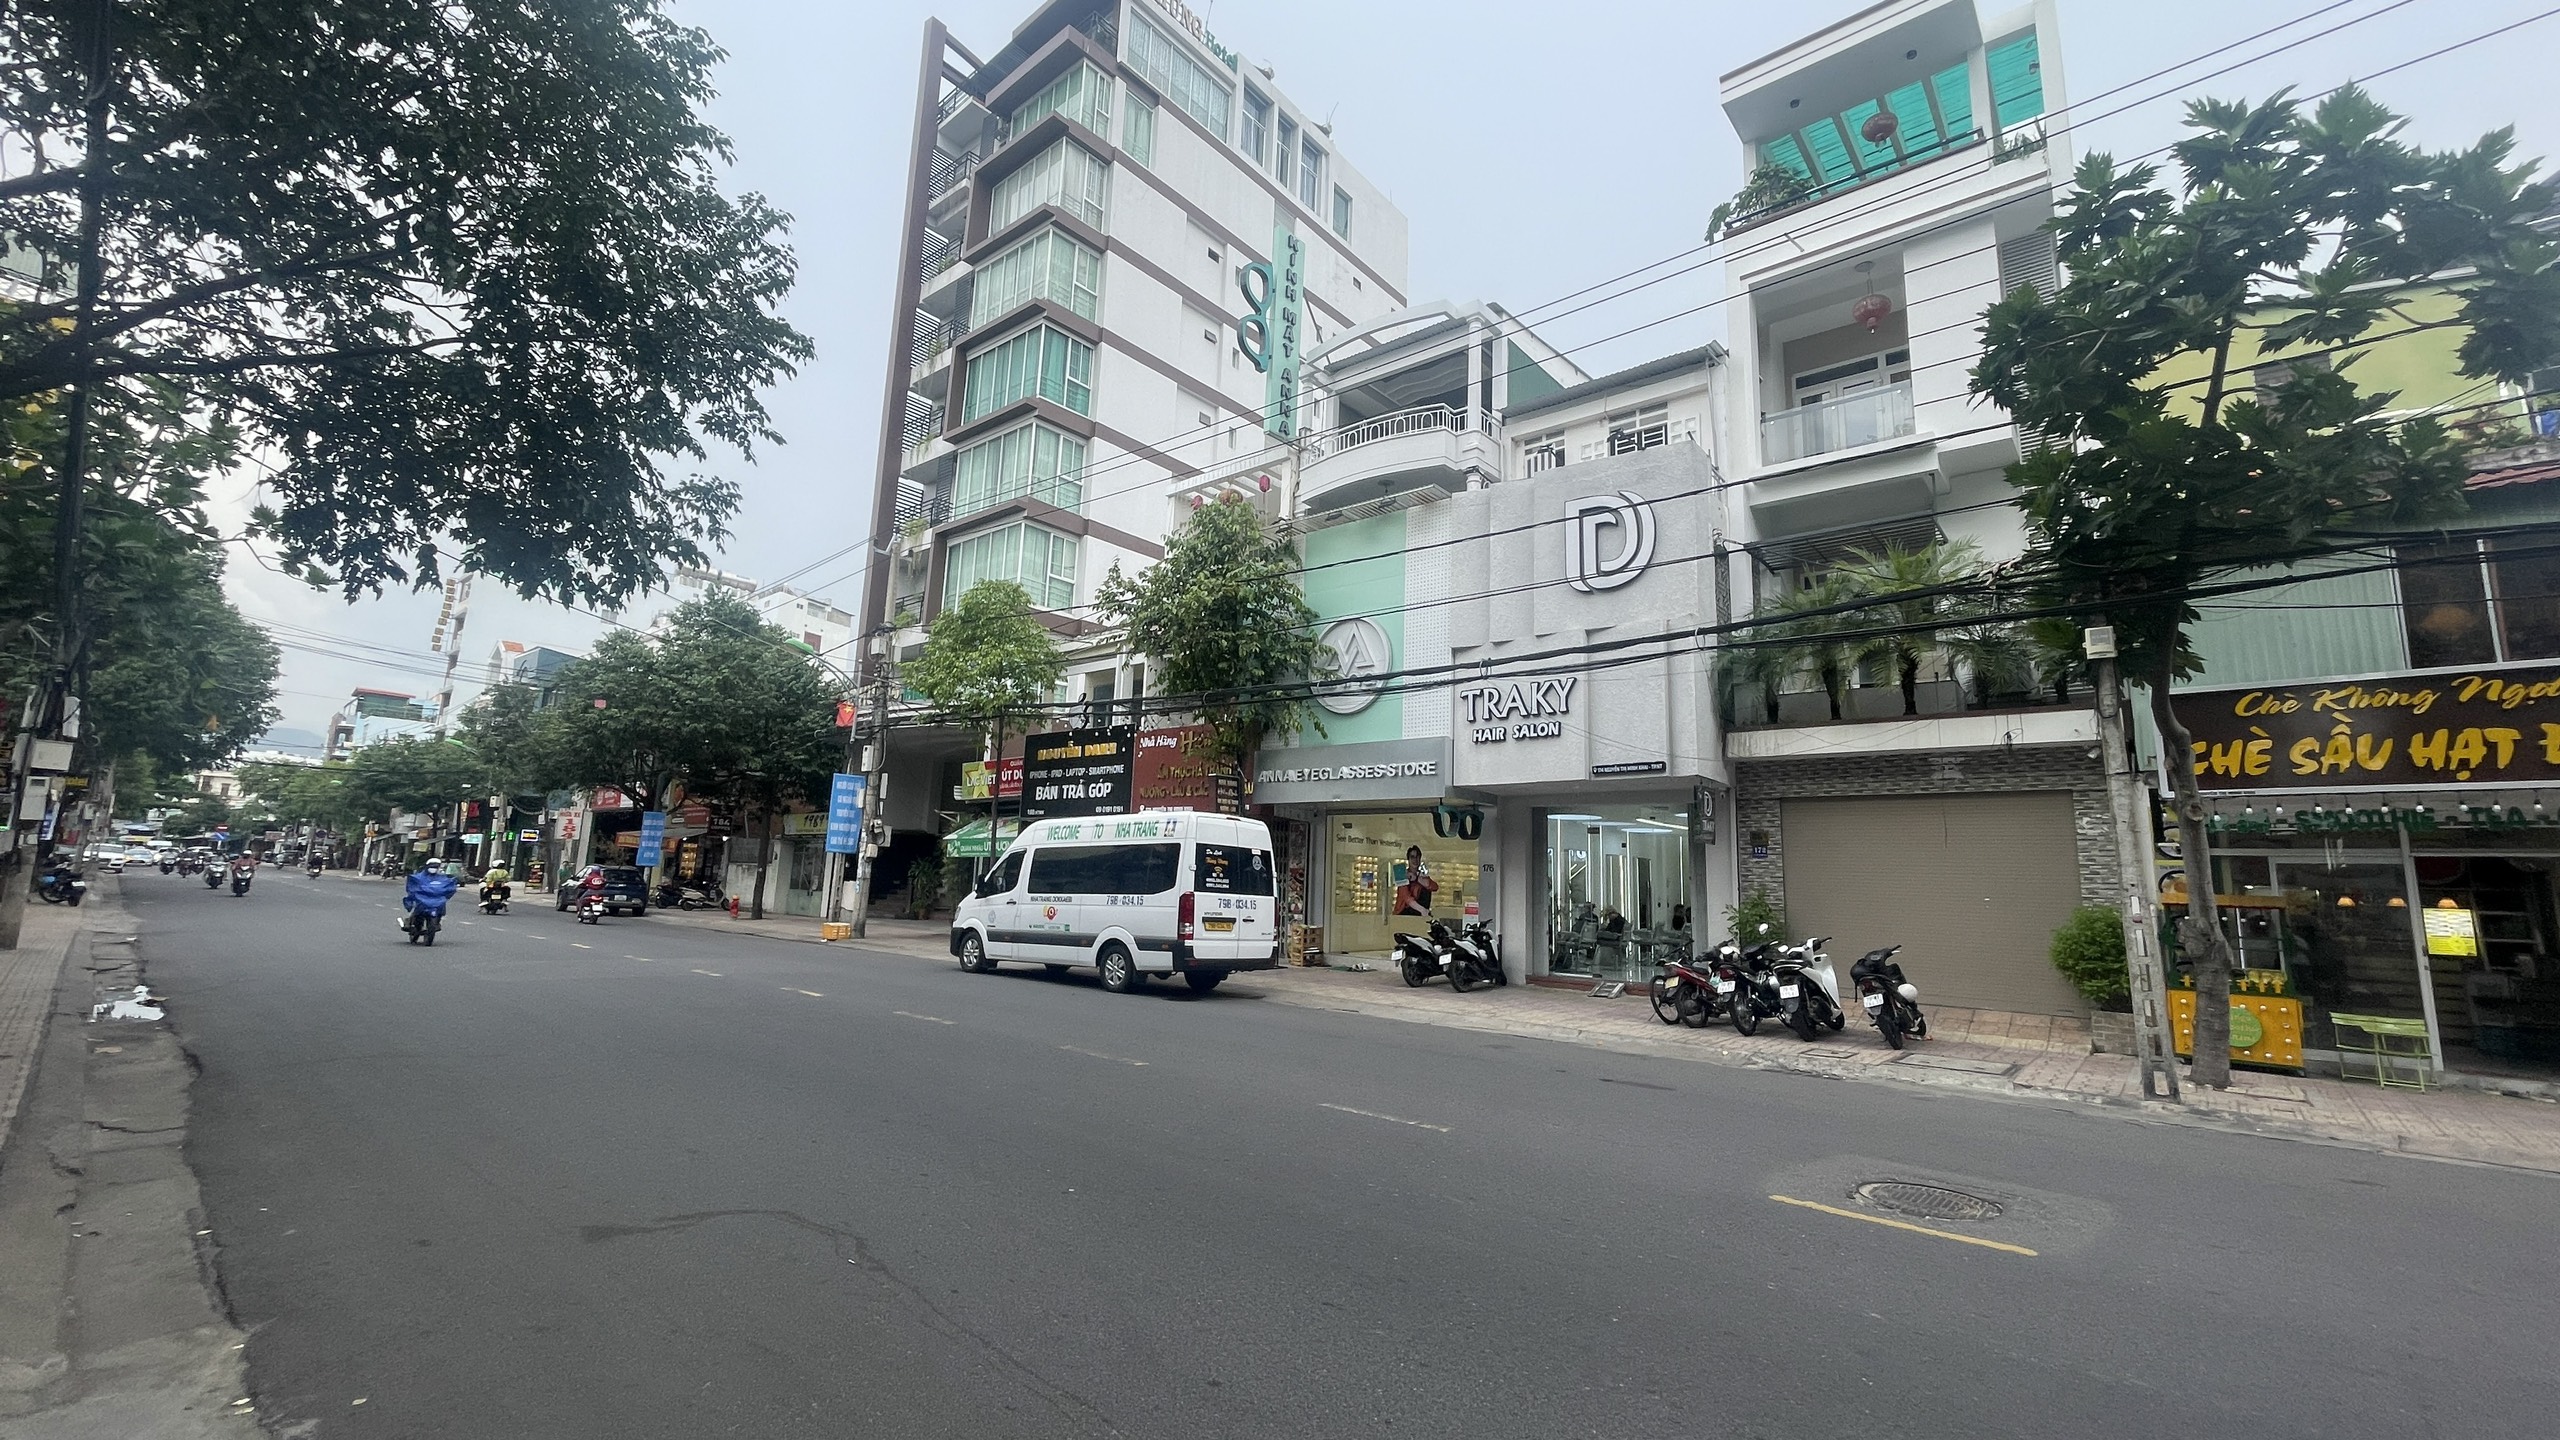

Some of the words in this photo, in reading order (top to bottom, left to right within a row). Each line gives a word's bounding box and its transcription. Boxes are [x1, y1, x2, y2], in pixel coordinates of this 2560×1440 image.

[1280, 368, 1293, 436] ANNA
[1461, 677, 1576, 722] TRAKY
[2235, 692, 2304, 717] Chè
[2310, 685, 2442, 715] Không
[1472, 726, 1506, 743] HAIR
[1512, 721, 1560, 739] SALON
[2191, 726, 2273, 778] CHÈ
[2289, 712, 2394, 776] SẦU
[2408, 727, 2522, 780] HẠT
[1029, 769, 1048, 779] IPHONE
[1051, 769, 1062, 778] IPAD
[1065, 767, 1086, 777] LAPTOP
[1088, 764, 1125, 776] SMARTPHONE
[1258, 769, 1294, 783] ANNA
[1296, 764, 1383, 782] EYEGLASSES
[1386, 761, 1437, 777] STORE
[1035, 782, 1058, 801] BÁN
[1062, 779, 1085, 799] TRẢ
[1088, 778, 1112, 798] GÓP
[712, 818, 731, 826] 184
[804, 814, 826, 828] 1989
[1046, 824, 1081, 841] WELCOME
[1093, 823, 1105, 840] TO
[1114, 821, 1132, 838] NHA
[1132, 820, 1160, 837] TRANG
[1336, 833, 1347, 842] See
[1347, 835, 1365, 844] Better
[1365, 836, 1379, 845] Than
[1379, 839, 1403, 849] Yesterday
[1481, 863, 1495, 873] 176
